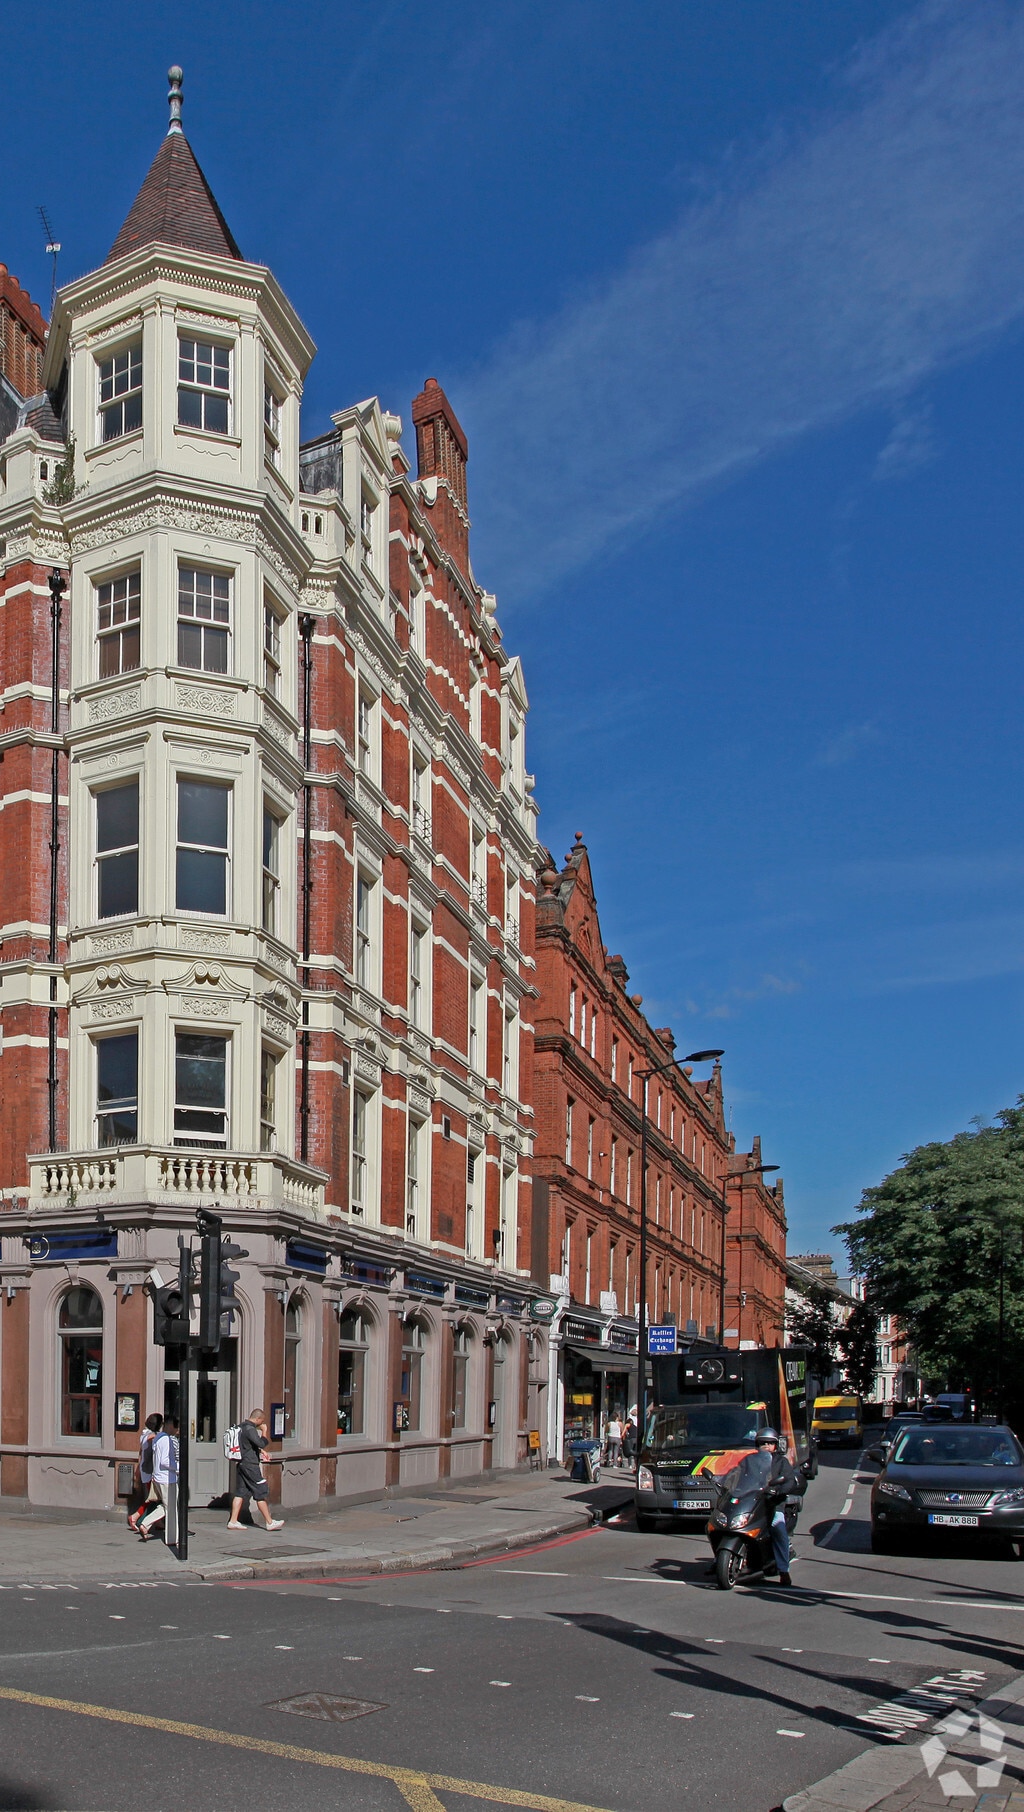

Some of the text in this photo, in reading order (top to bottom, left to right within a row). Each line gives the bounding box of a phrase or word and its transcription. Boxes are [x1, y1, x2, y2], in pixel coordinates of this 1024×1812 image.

[949, 1516, 960, 1524] AK
[961, 1517, 977, 1525] 888
[837, 1702, 934, 1739] LOOK
